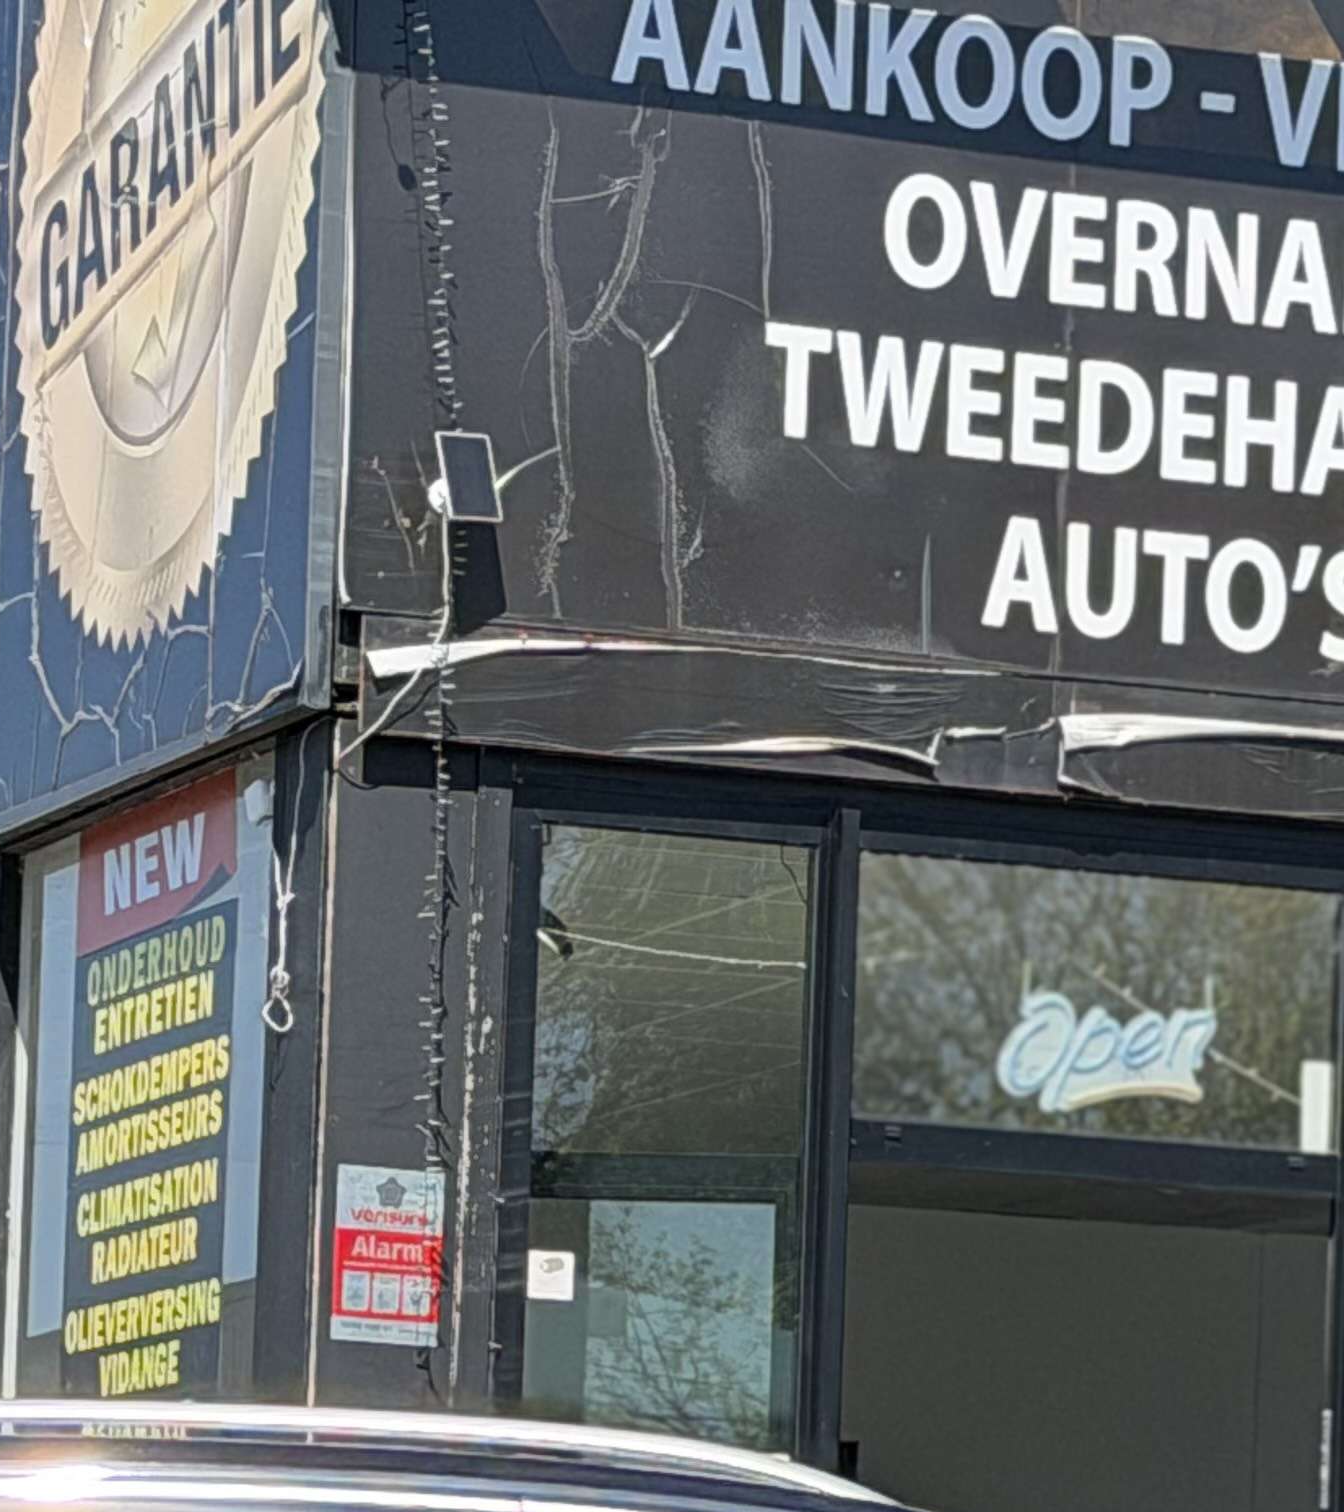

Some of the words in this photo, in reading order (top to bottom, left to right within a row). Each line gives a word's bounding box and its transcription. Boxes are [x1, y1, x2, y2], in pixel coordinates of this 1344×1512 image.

[611, 0, 1173, 148] AANKOOP
[40, 0, 303, 350] GARANTIE
[102, 811, 206, 917] NEW
[87, 914, 227, 1008] ONDERHOUD
[93, 969, 215, 1056] ENTRETIEN
[997, 991, 1216, 1113] Open
[73, 1033, 231, 1127] SCHOKDEMPERS
[74, 1088, 224, 1177] AMORTISSEURS
[75, 1156, 219, 1238] CLIMATISATION
[91, 1216, 198, 1285] RADIATEUR
[351, 1234, 424, 1262] Alarm
[64, 1276, 221, 1355] OLIEVERVERSING
[98, 1338, 182, 1398] VIDANGE
